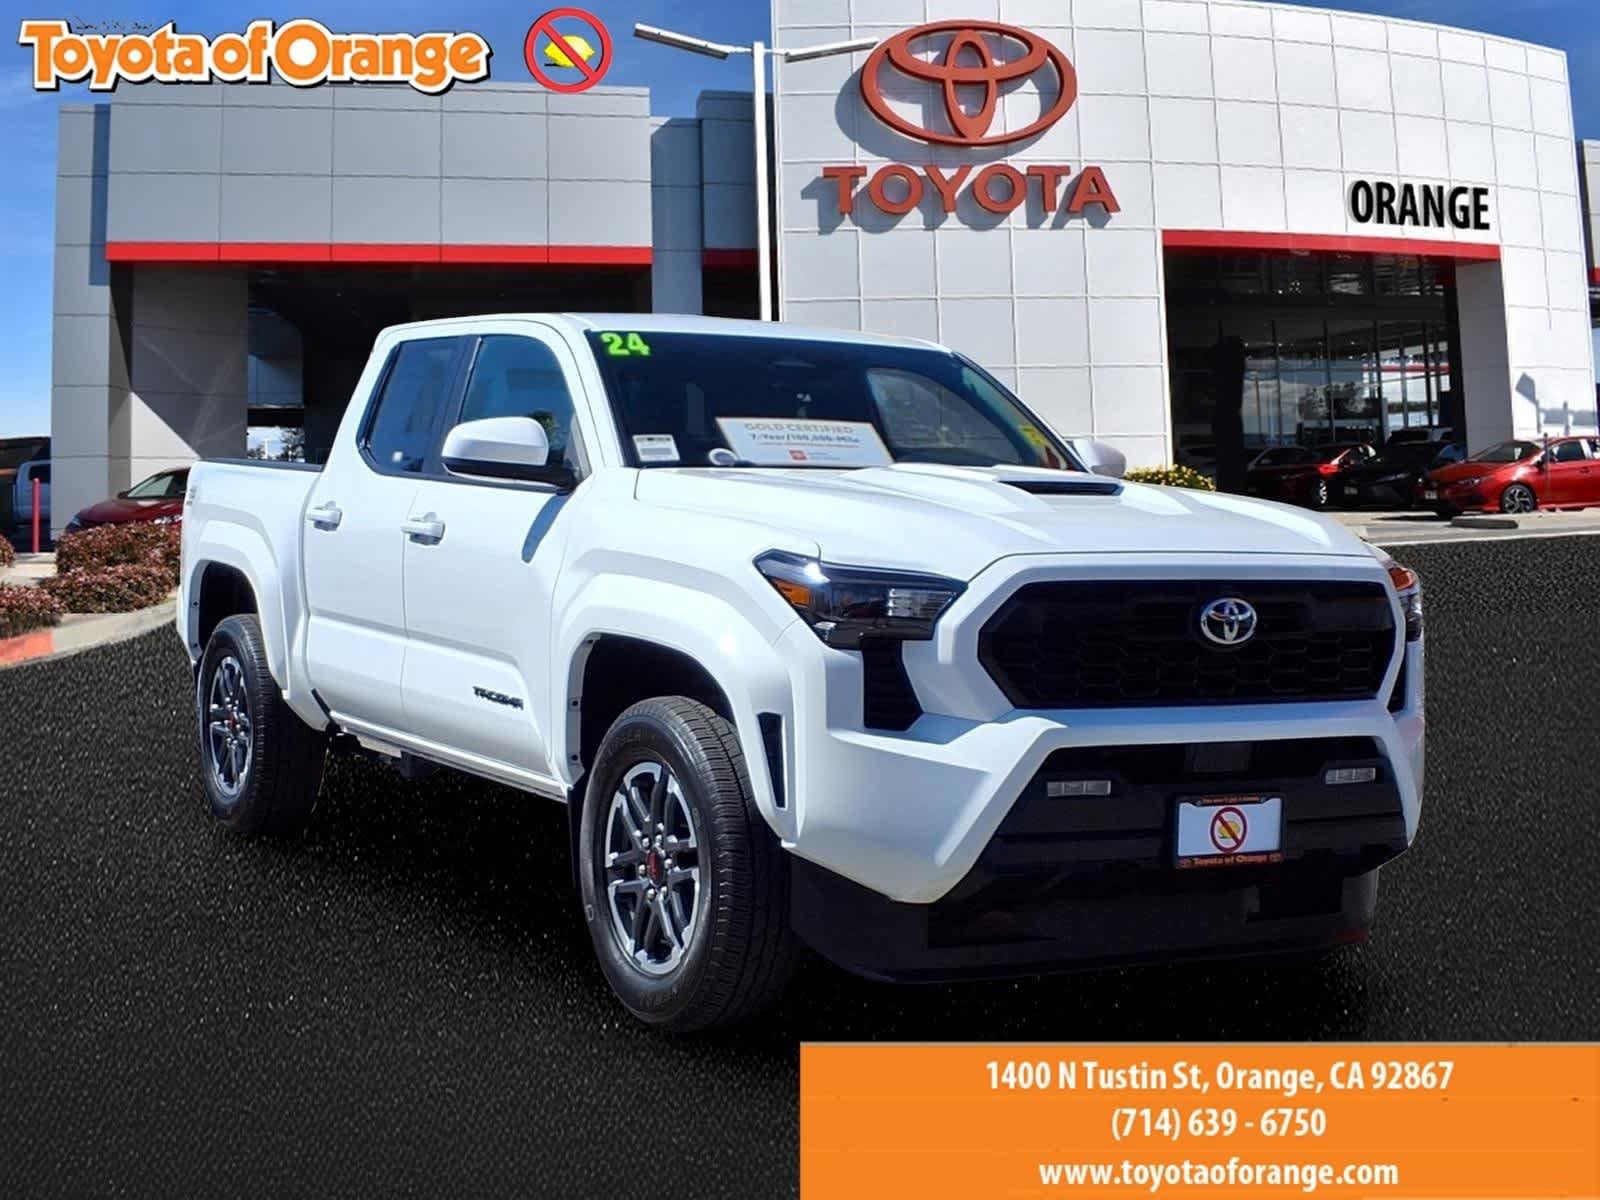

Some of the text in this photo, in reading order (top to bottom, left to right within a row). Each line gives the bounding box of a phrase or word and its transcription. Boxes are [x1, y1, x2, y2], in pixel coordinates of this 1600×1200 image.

[824, 164, 1119, 216] TOYOTA
[1350, 180, 1491, 230] ORANGE
[601, 332, 651, 356] 24
[786, 423, 855, 434] CERTIFIED
